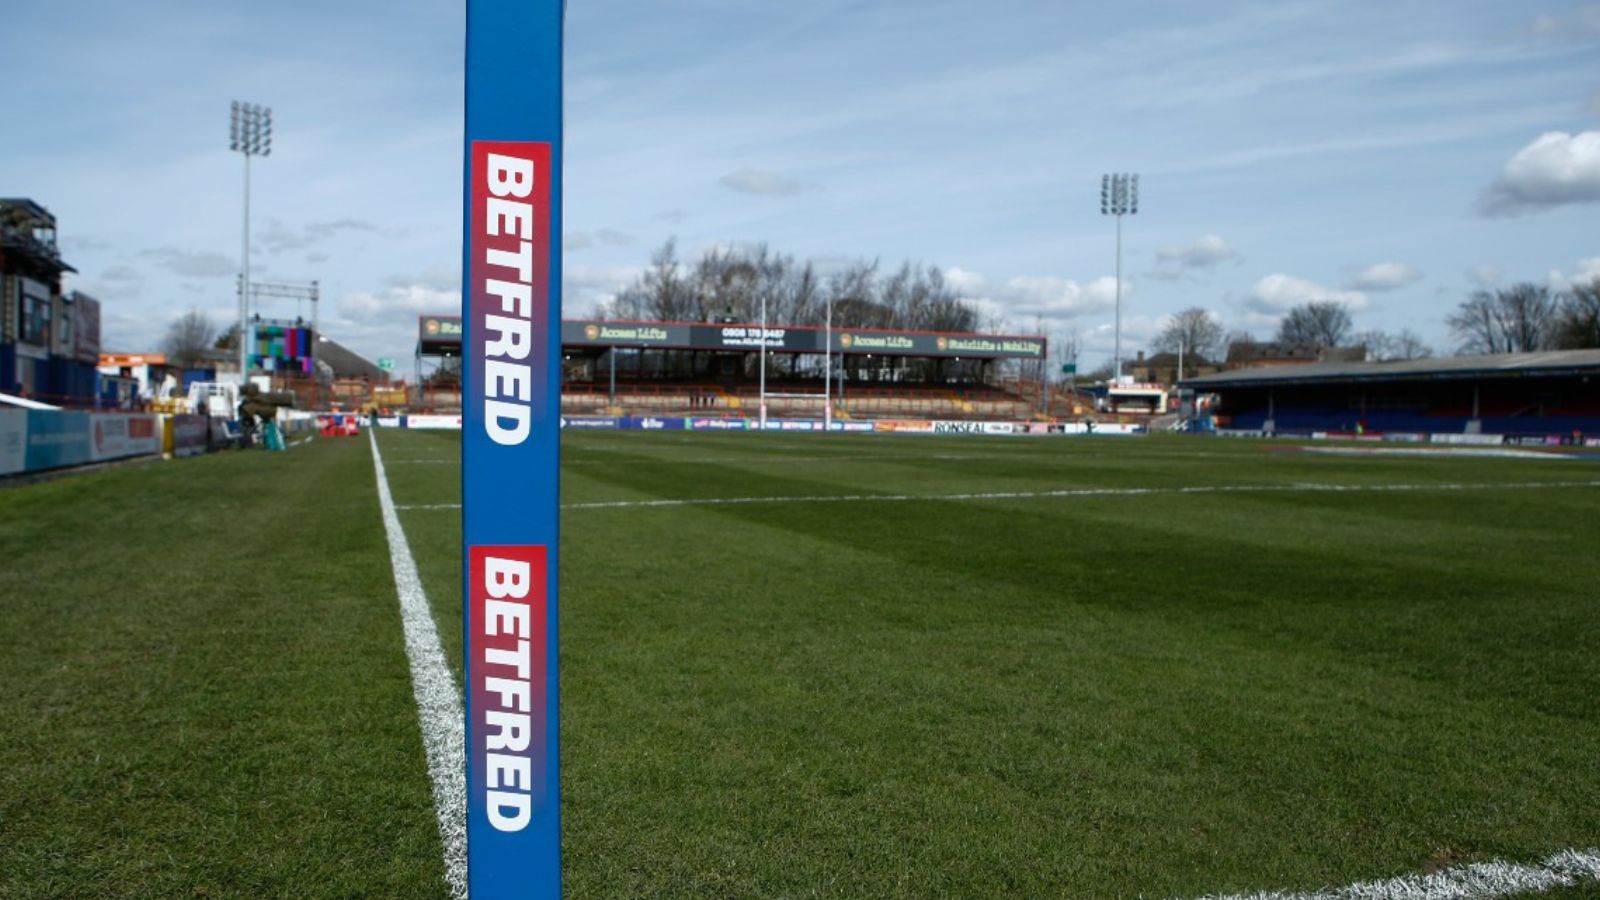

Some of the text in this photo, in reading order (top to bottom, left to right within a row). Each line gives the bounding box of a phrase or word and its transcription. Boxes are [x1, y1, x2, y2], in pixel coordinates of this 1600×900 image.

[484, 152, 534, 446] BETFRED
[600, 326, 667, 340] Access Lifts
[853, 335, 913, 348] Access Lifts
[934, 422, 985, 433] RONSEAL
[485, 556, 531, 832] BETFRED
